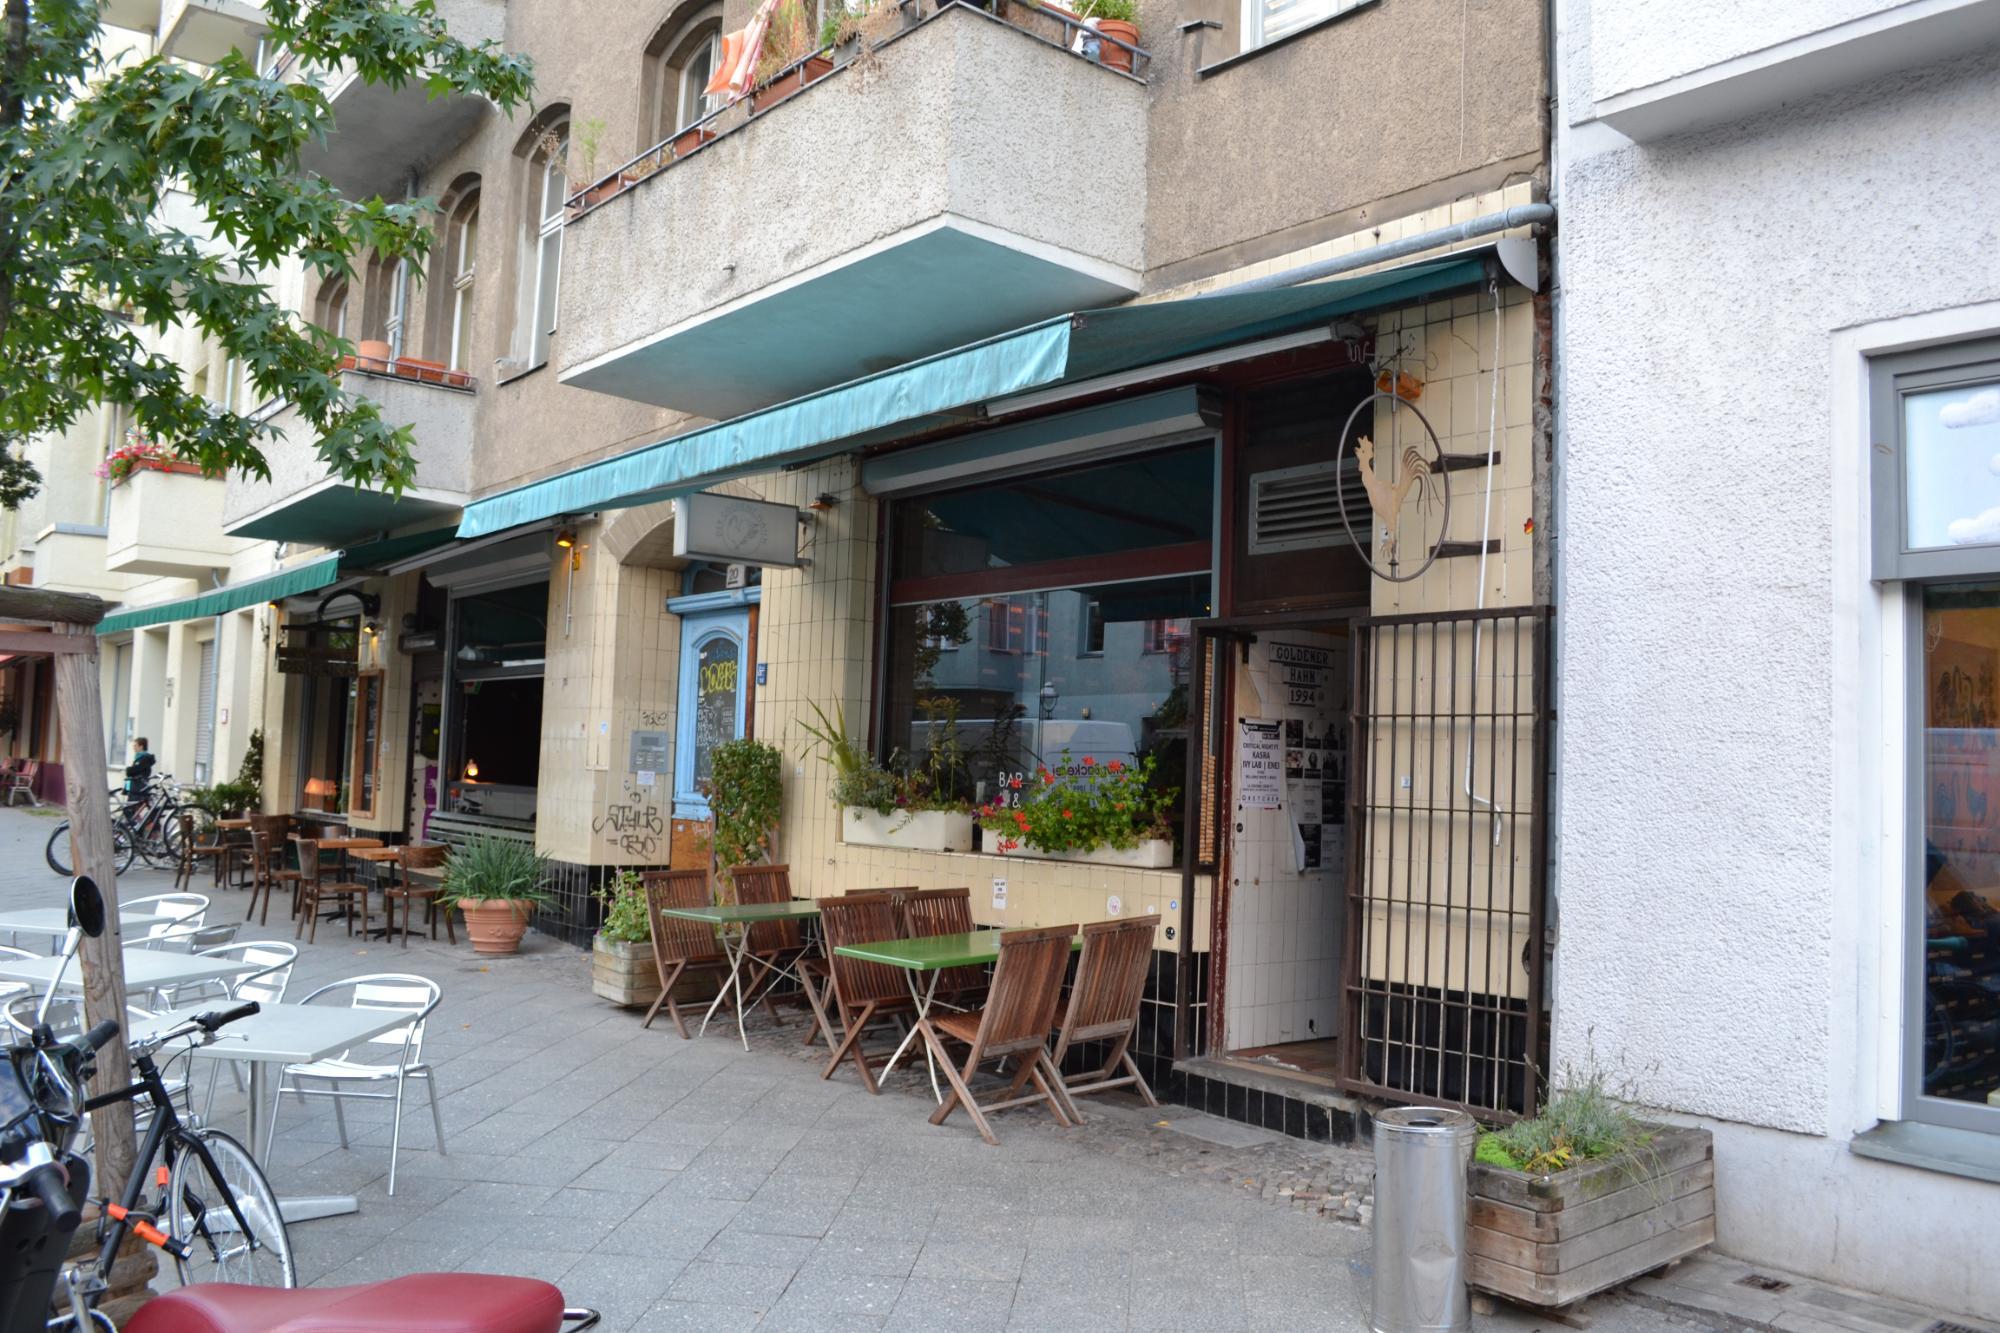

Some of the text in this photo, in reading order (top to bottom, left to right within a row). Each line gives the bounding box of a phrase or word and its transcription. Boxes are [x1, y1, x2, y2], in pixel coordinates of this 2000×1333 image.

[729, 568, 739, 580] 20
[1290, 689, 1315, 703] 1994
[1252, 751, 1271, 760] KASRA
[1251, 761, 1262, 770] LAB
[998, 771, 1024, 789] BAR
[1012, 792, 1021, 809] &
